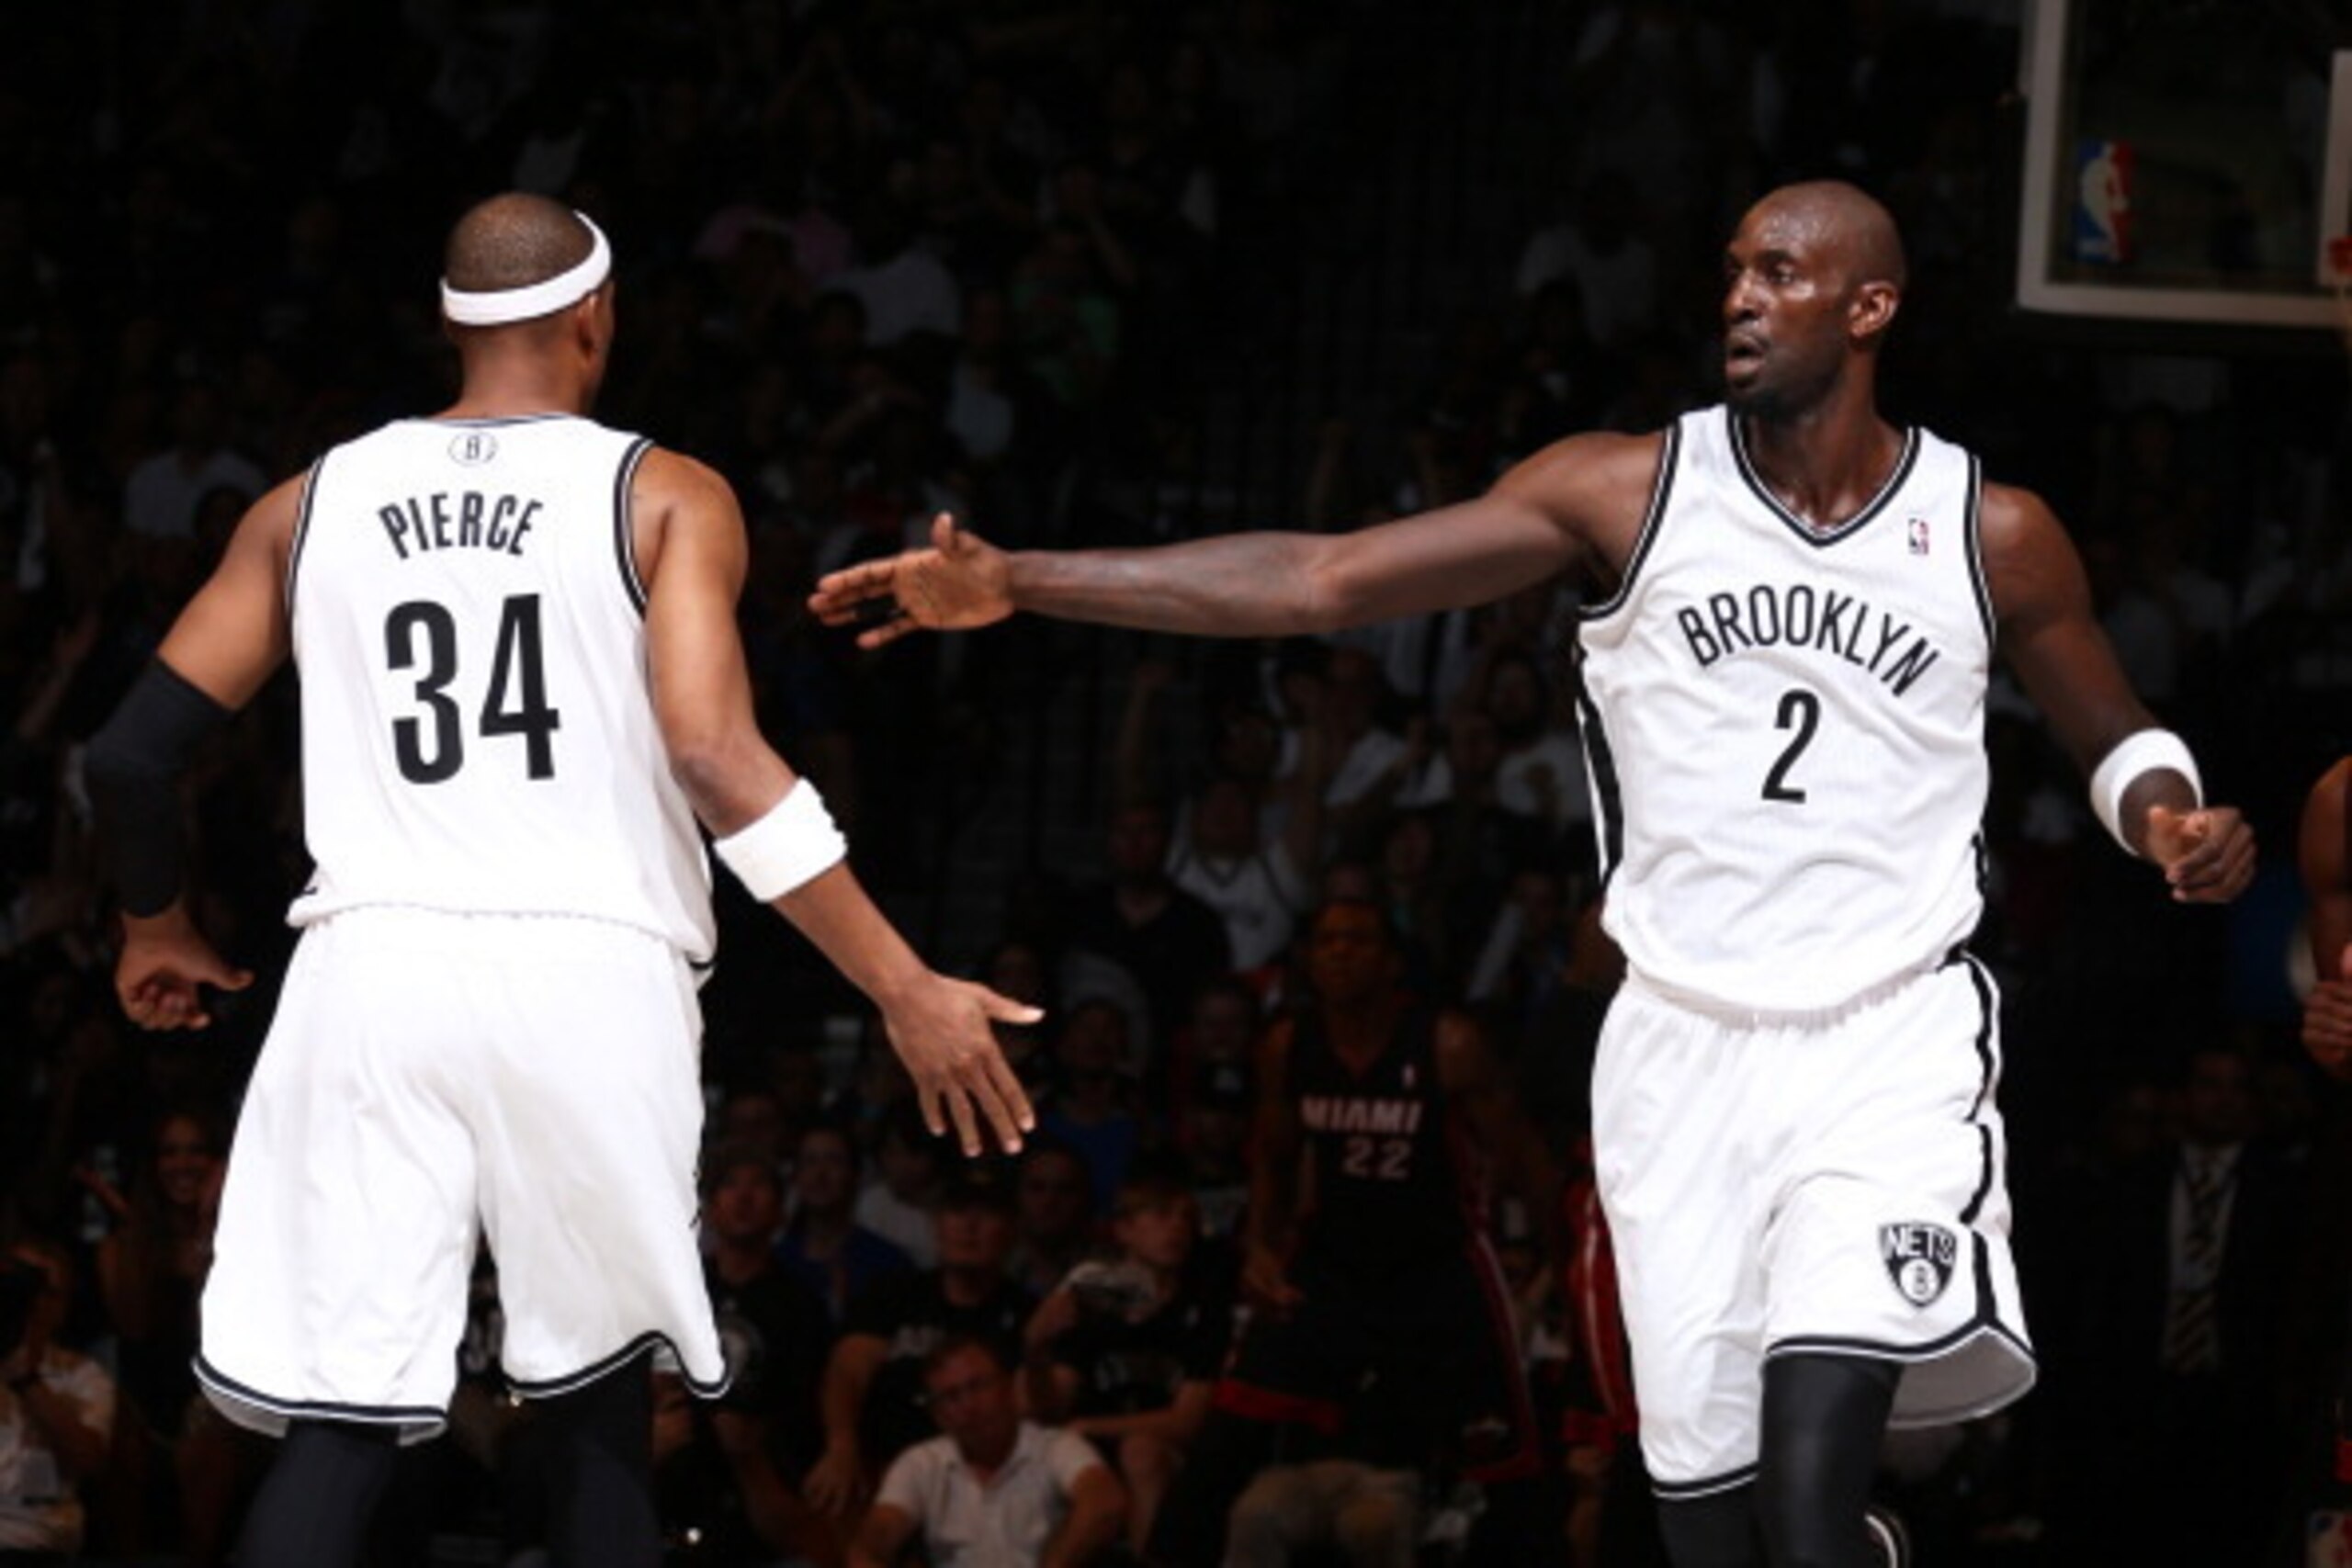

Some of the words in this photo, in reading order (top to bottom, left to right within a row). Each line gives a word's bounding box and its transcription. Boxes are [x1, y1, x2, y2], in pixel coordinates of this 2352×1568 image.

[378, 491, 544, 558] PIERCE
[1678, 583, 1939, 696] BROOKLYN
[385, 593, 560, 784] 34
[1761, 689, 1820, 803] 2
[1298, 1093, 1425, 1134] MIAMI
[1341, 1135, 1413, 1181] 22
[1881, 1224, 1955, 1265] NETS
